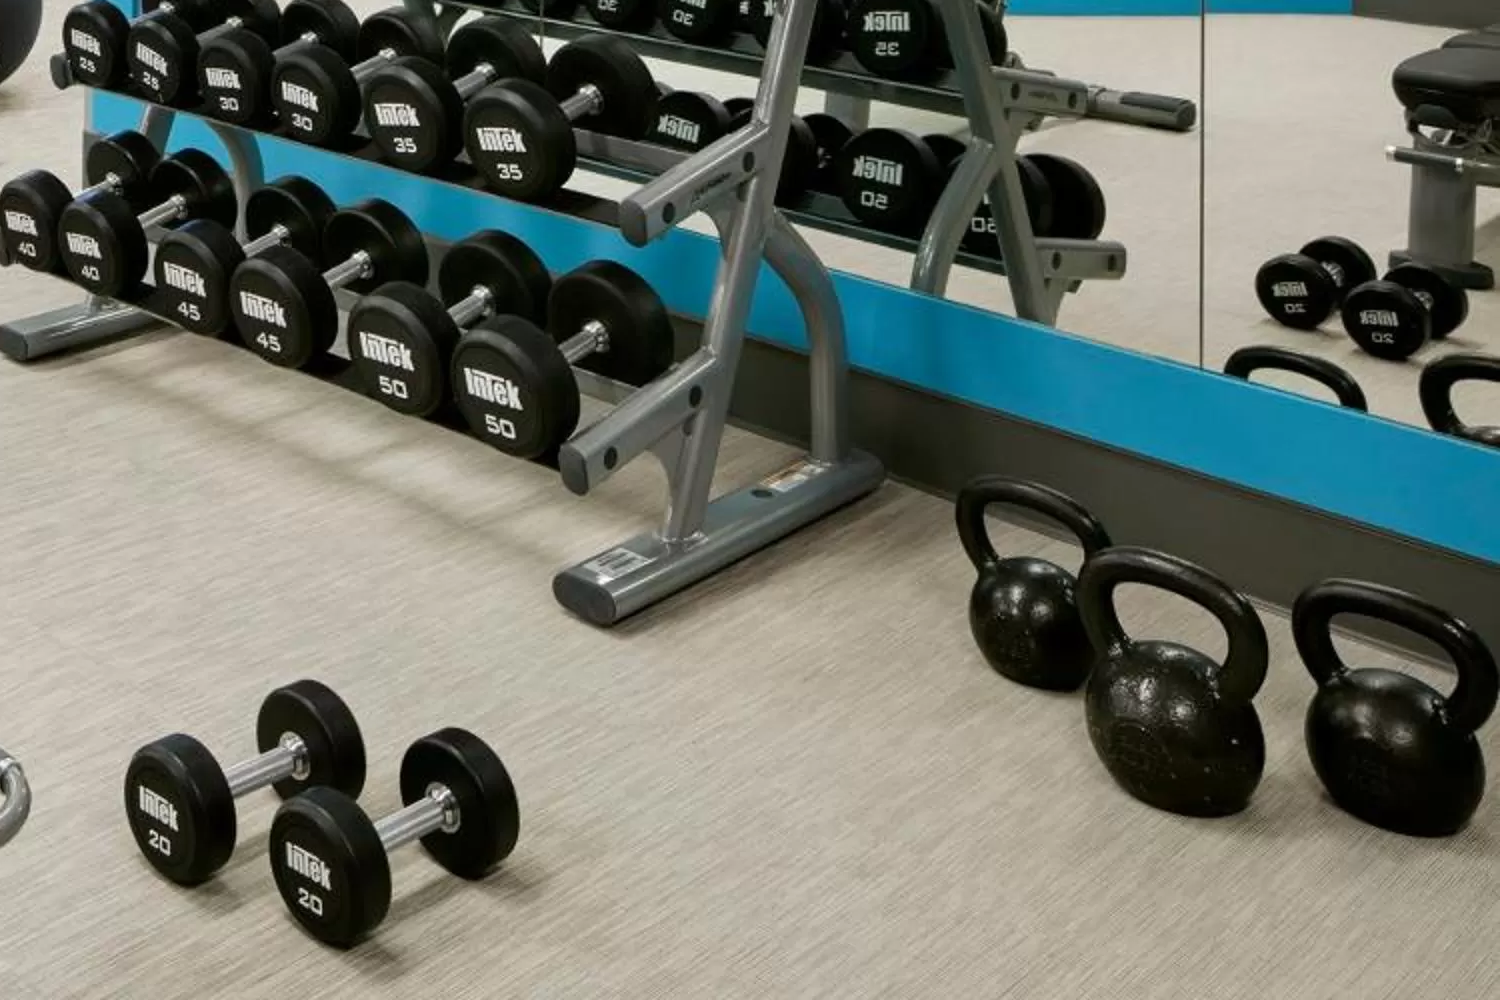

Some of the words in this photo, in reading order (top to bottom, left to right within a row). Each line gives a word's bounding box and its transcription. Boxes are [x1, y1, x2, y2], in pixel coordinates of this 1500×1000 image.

[80, 57, 97, 72] 25
[143, 72, 160, 91] 25
[220, 97, 239, 111] 30
[291, 113, 312, 132] 30
[394, 138, 417, 153] 35
[497, 164, 522, 180] 35
[19, 242, 36, 256] 40
[82, 266, 100, 280] 40
[178, 301, 201, 321] 45
[256, 332, 282, 353] 45
[379, 375, 408, 400] 50
[485, 414, 516, 439] 50
[149, 828, 170, 857] 20
[298, 887, 323, 917] 20
